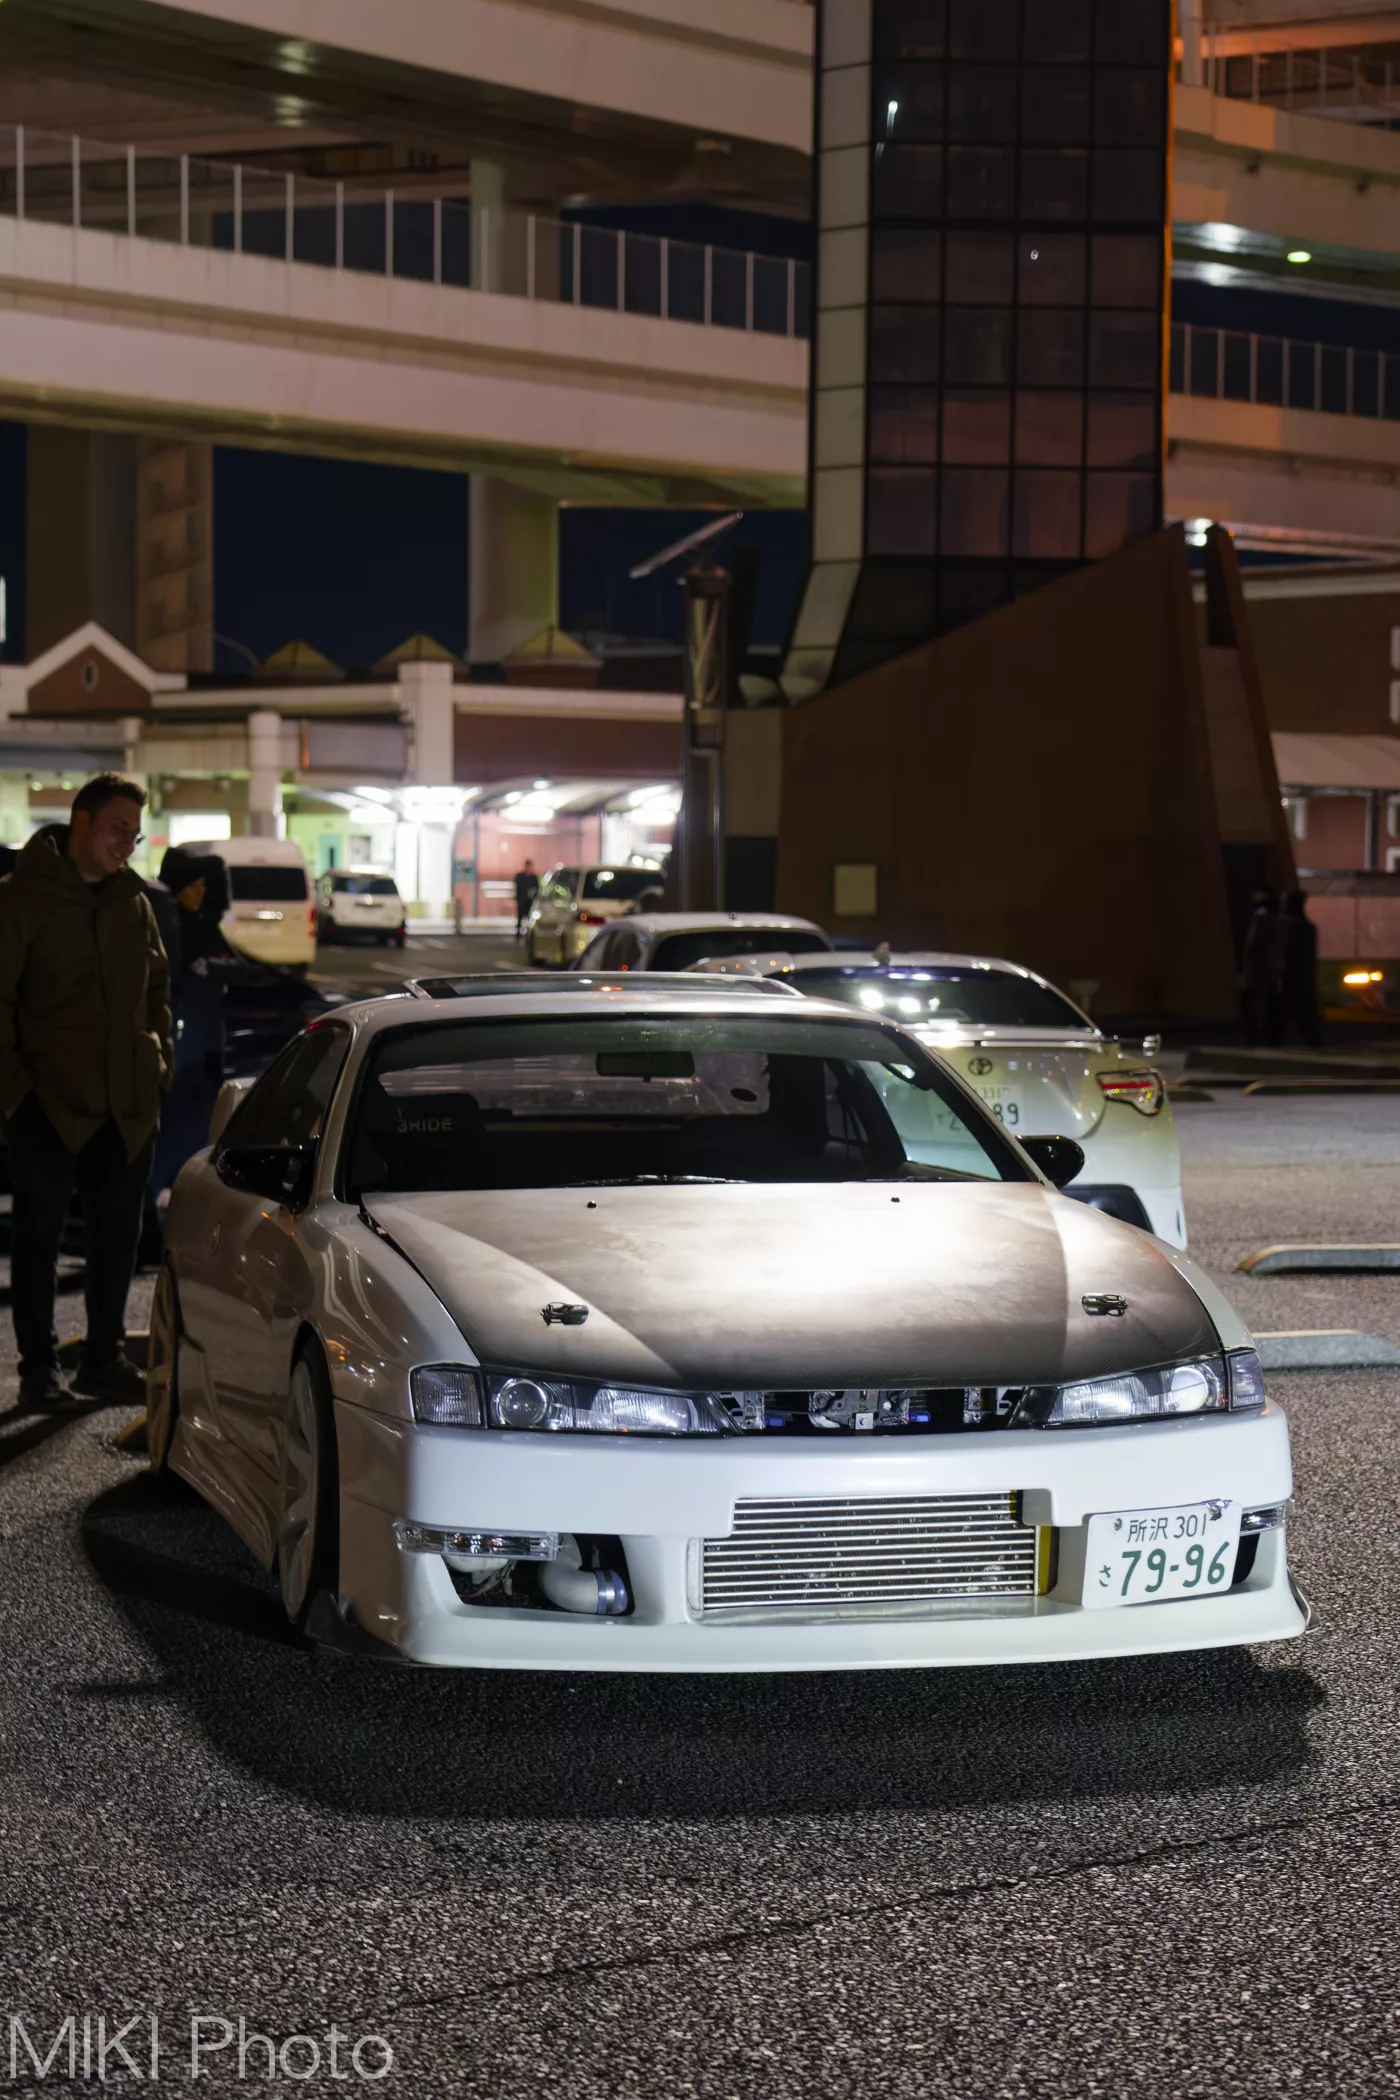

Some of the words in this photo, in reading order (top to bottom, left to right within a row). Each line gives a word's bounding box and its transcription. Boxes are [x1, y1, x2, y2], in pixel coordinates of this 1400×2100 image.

[1127, 1517, 1168, 1543] 所沢
[1173, 1513, 1206, 1539] 301
[1098, 1565, 1111, 1587] さ
[1121, 1541, 1230, 1597] 79-96
